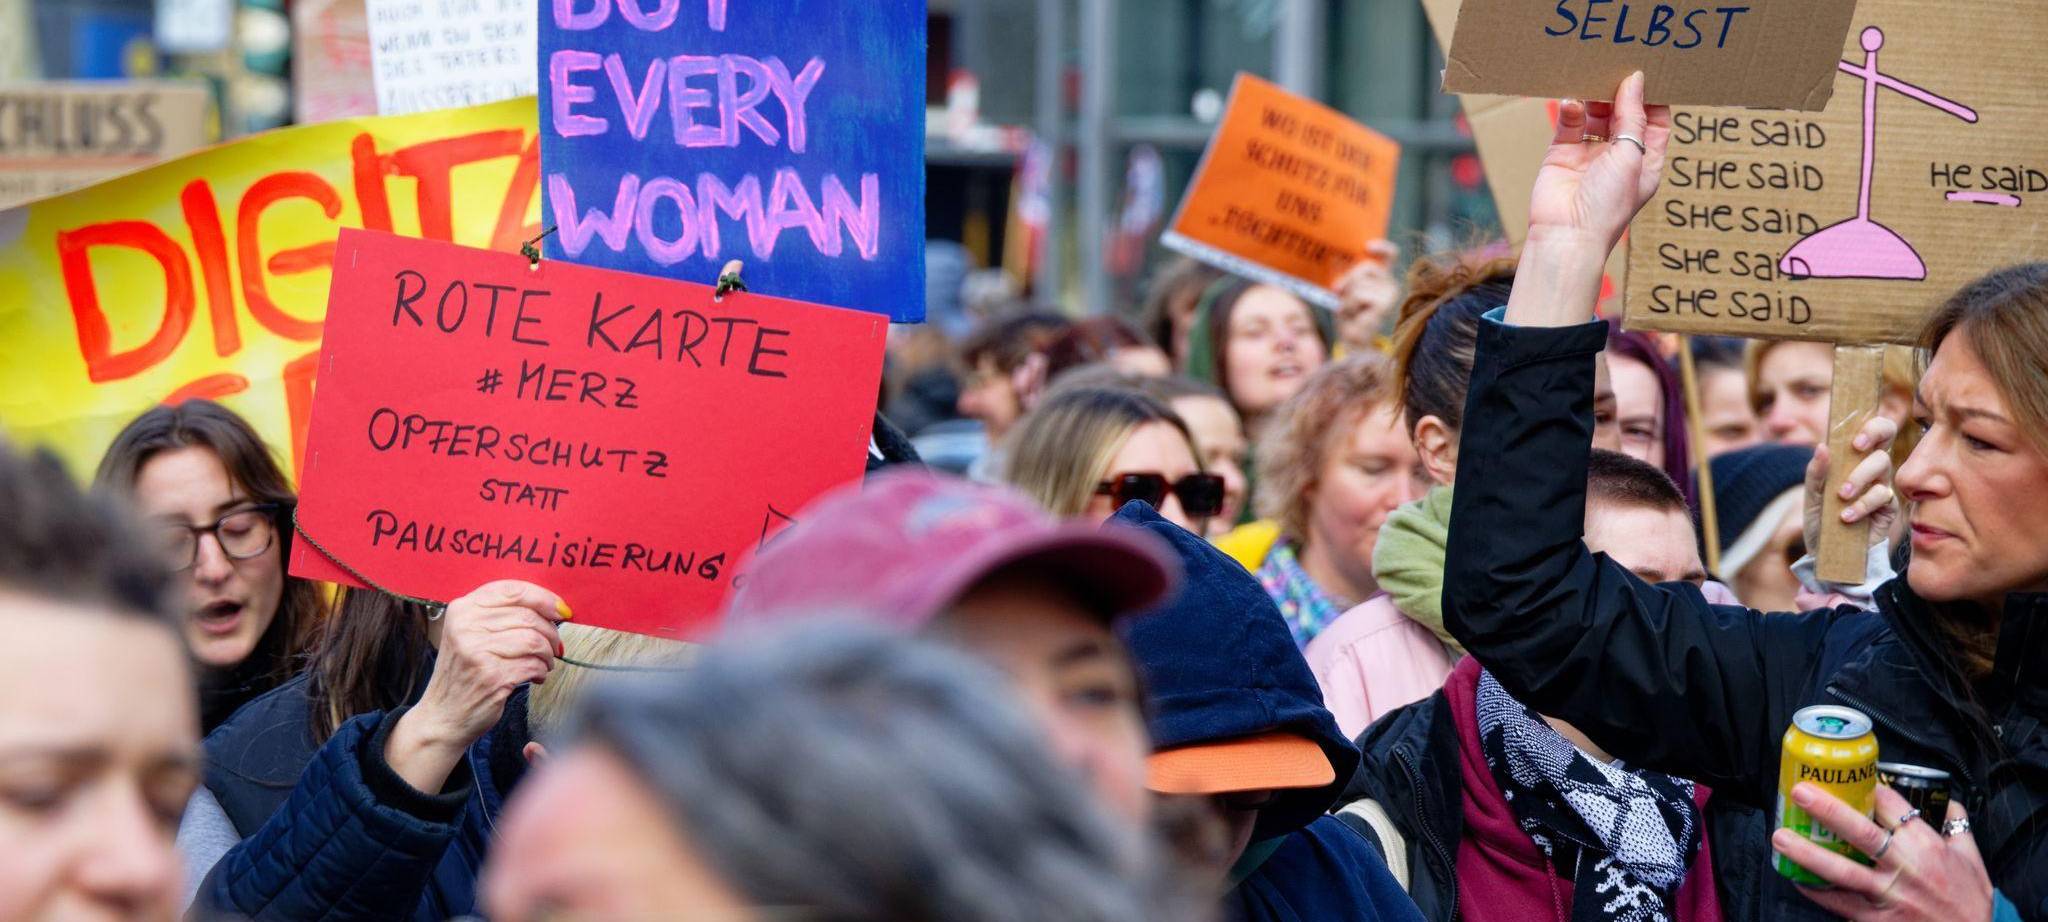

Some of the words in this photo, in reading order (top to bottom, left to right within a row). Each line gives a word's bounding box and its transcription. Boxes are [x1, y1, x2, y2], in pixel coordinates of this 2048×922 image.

[1545, 0, 1750, 49] SELBST
[550, 49, 827, 154] EVERY
[1930, 161, 1973, 189] He
[548, 166, 880, 267] WOMAN
[392, 269, 553, 347] ROTE
[587, 292, 791, 378] KARTE
[479, 478, 570, 512] STATT
[1800, 763, 1878, 785] PAULANE
